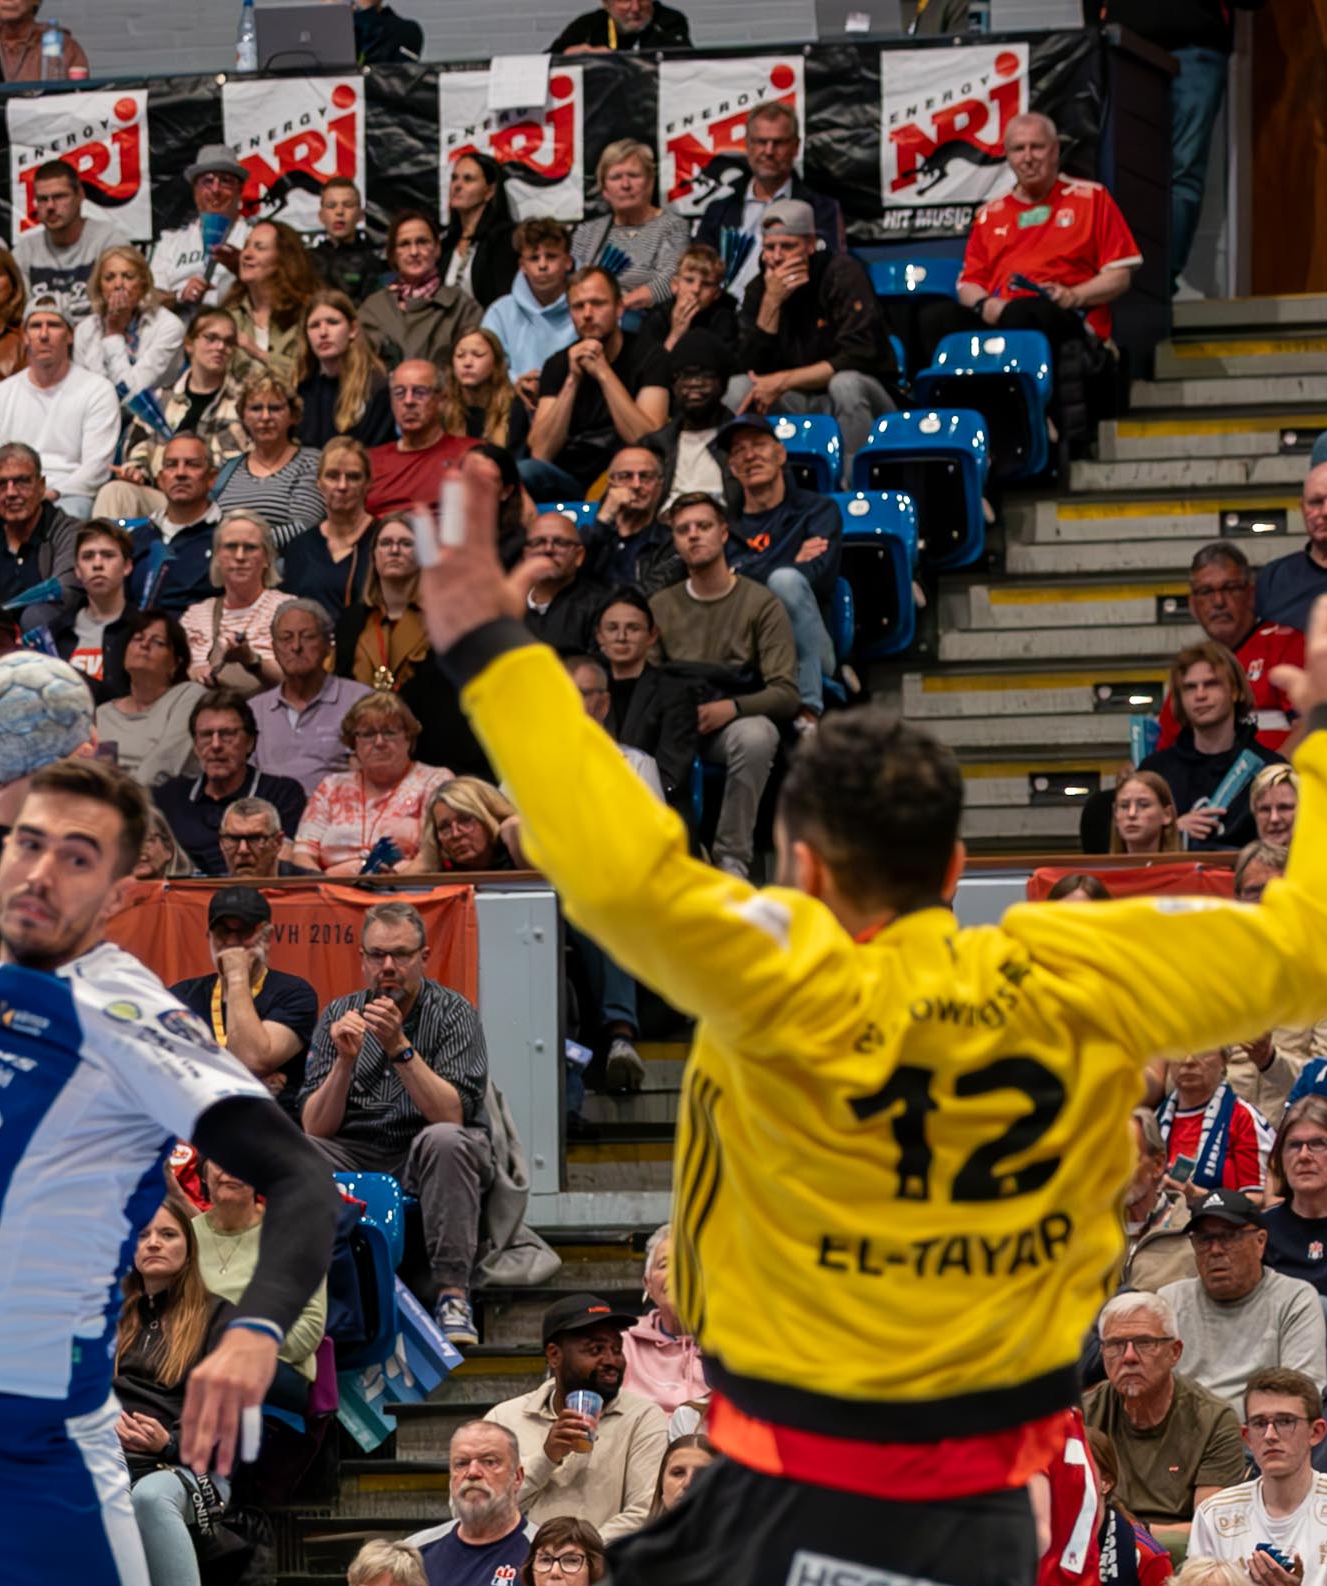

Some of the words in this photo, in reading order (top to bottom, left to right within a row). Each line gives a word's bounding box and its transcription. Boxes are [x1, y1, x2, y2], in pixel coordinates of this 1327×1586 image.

[666, 87, 768, 133] ENERGY
[890, 74, 989, 123] ENERGY
[19, 120, 111, 166] ENERGY
[234, 107, 326, 153] ENERGY
[310, 923, 354, 945] 2016
[847, 1056, 1067, 1203] 12
[817, 1212, 1075, 1280] EL-TAYAR
